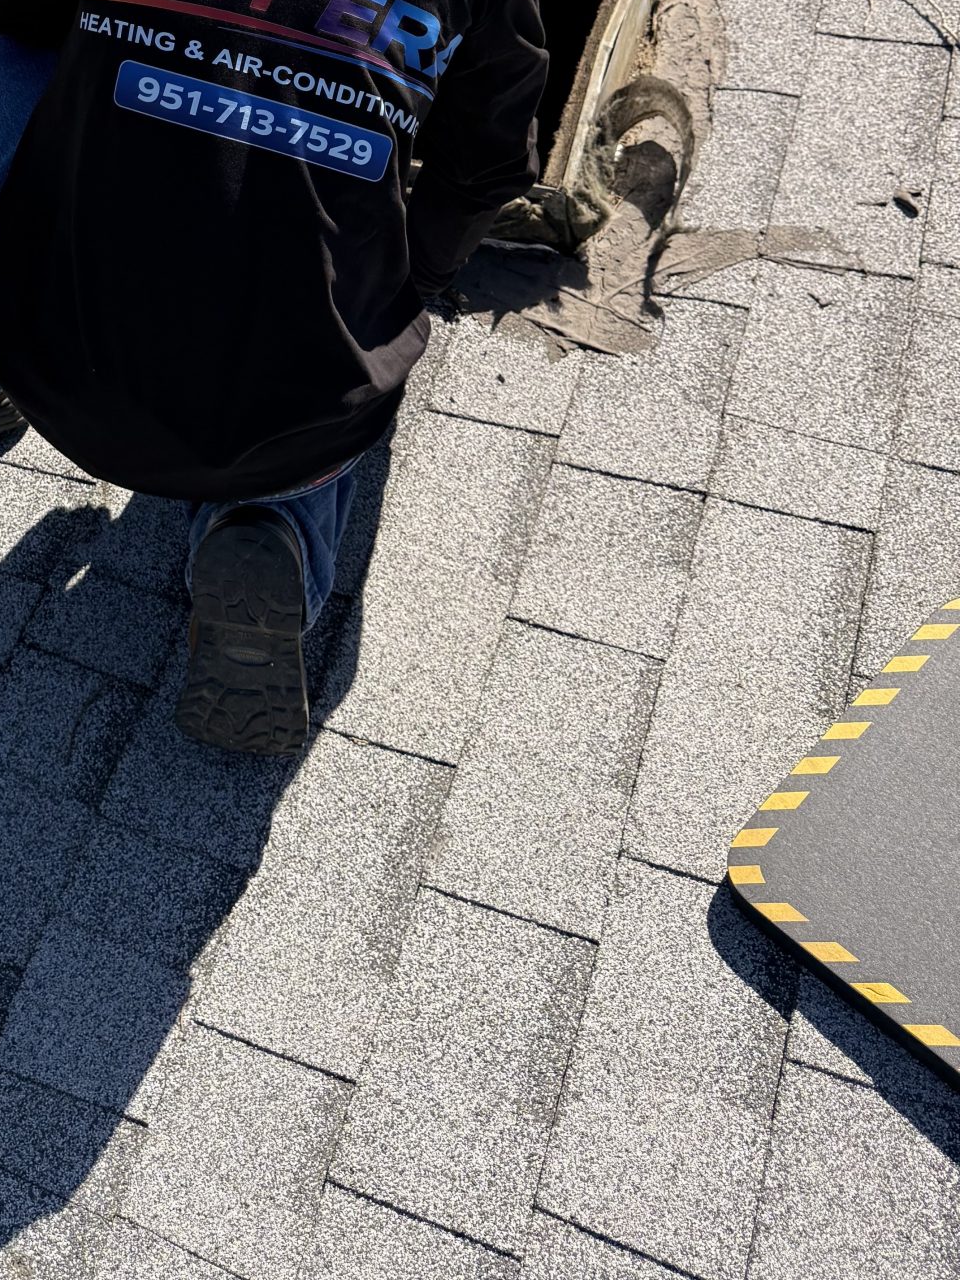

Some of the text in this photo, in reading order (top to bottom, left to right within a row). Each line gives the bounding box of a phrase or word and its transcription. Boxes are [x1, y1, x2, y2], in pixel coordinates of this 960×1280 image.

[80, 11, 176, 53] HEATING
[184, 39, 205, 60] &
[137, 75, 373, 166] 951-713-7529
